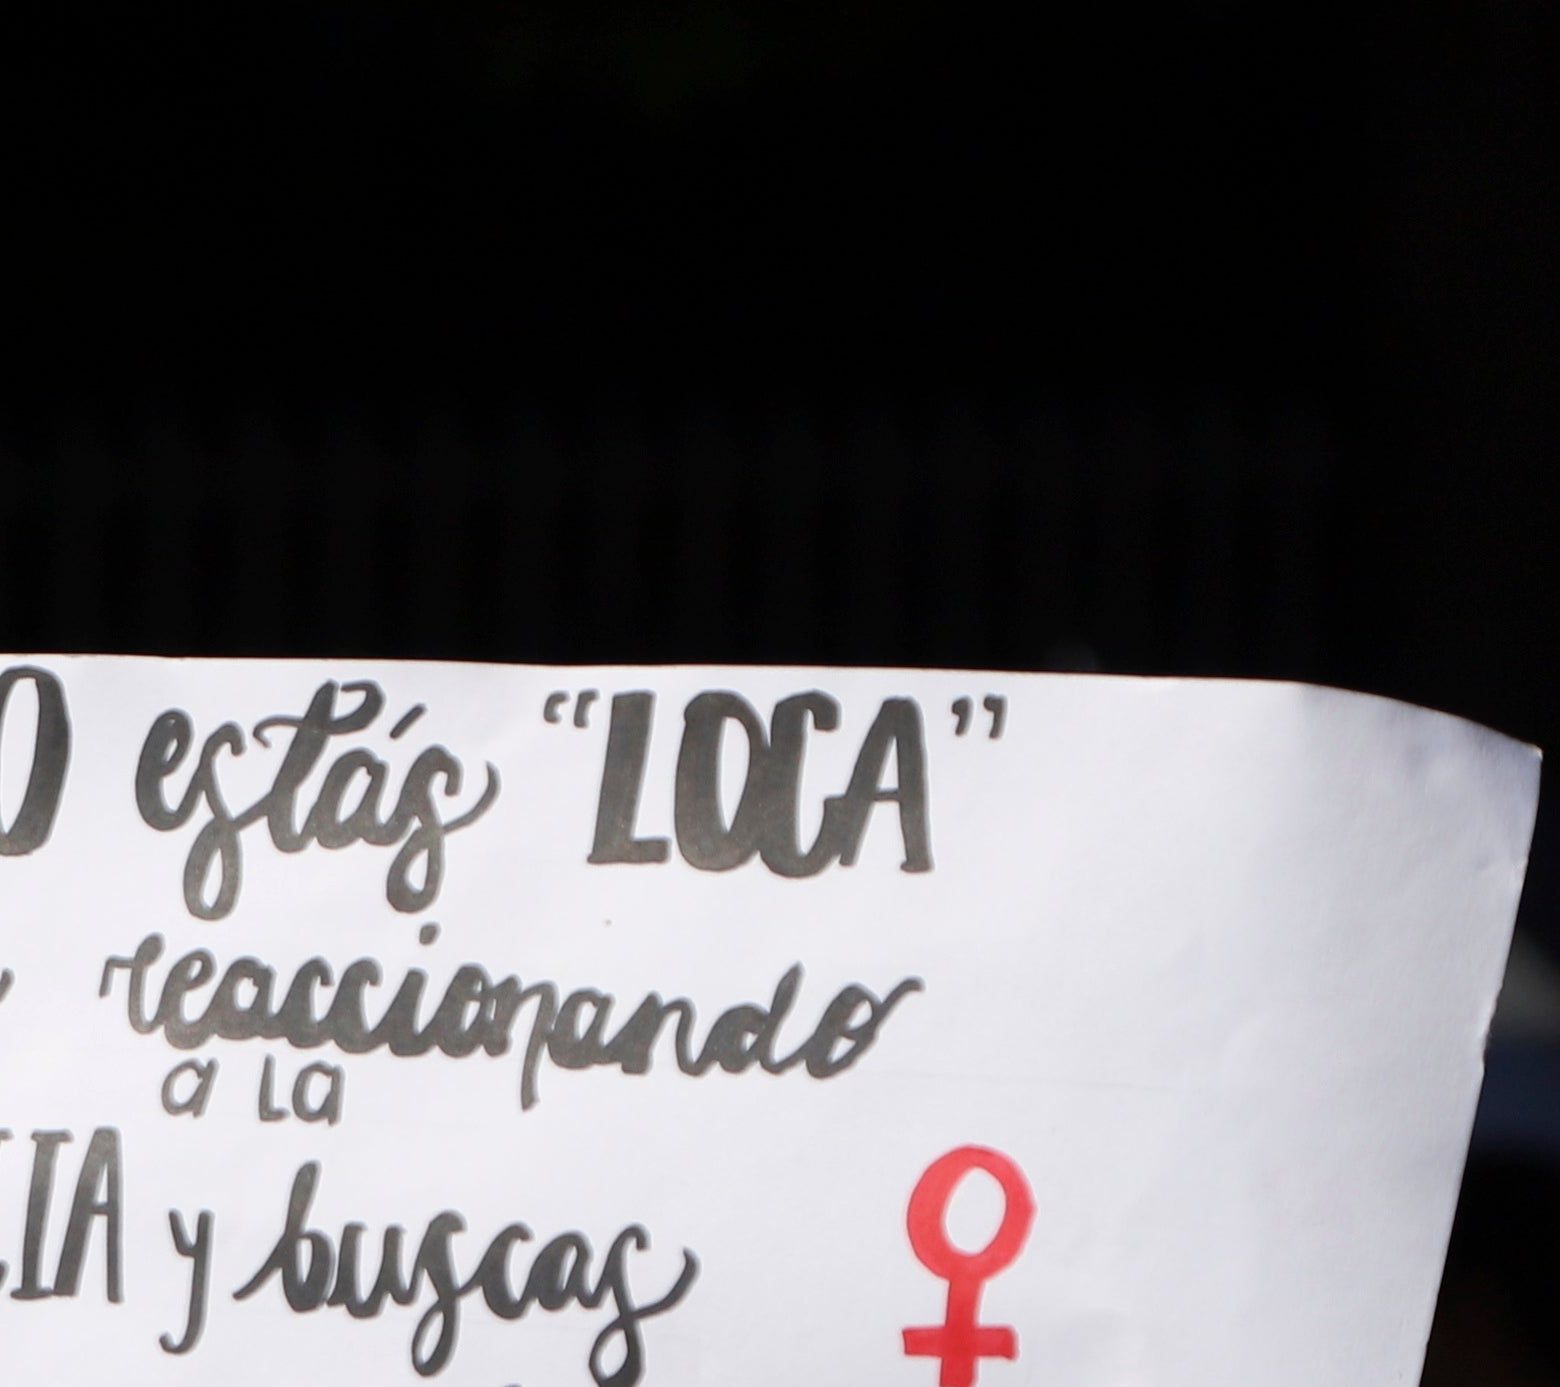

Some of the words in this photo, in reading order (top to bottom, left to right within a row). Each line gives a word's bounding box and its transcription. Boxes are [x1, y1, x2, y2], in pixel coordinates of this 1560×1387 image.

[99, 921, 923, 1110] reaccionando
[162, 1058, 217, 1117] a
[159, 1211, 211, 1355] y
